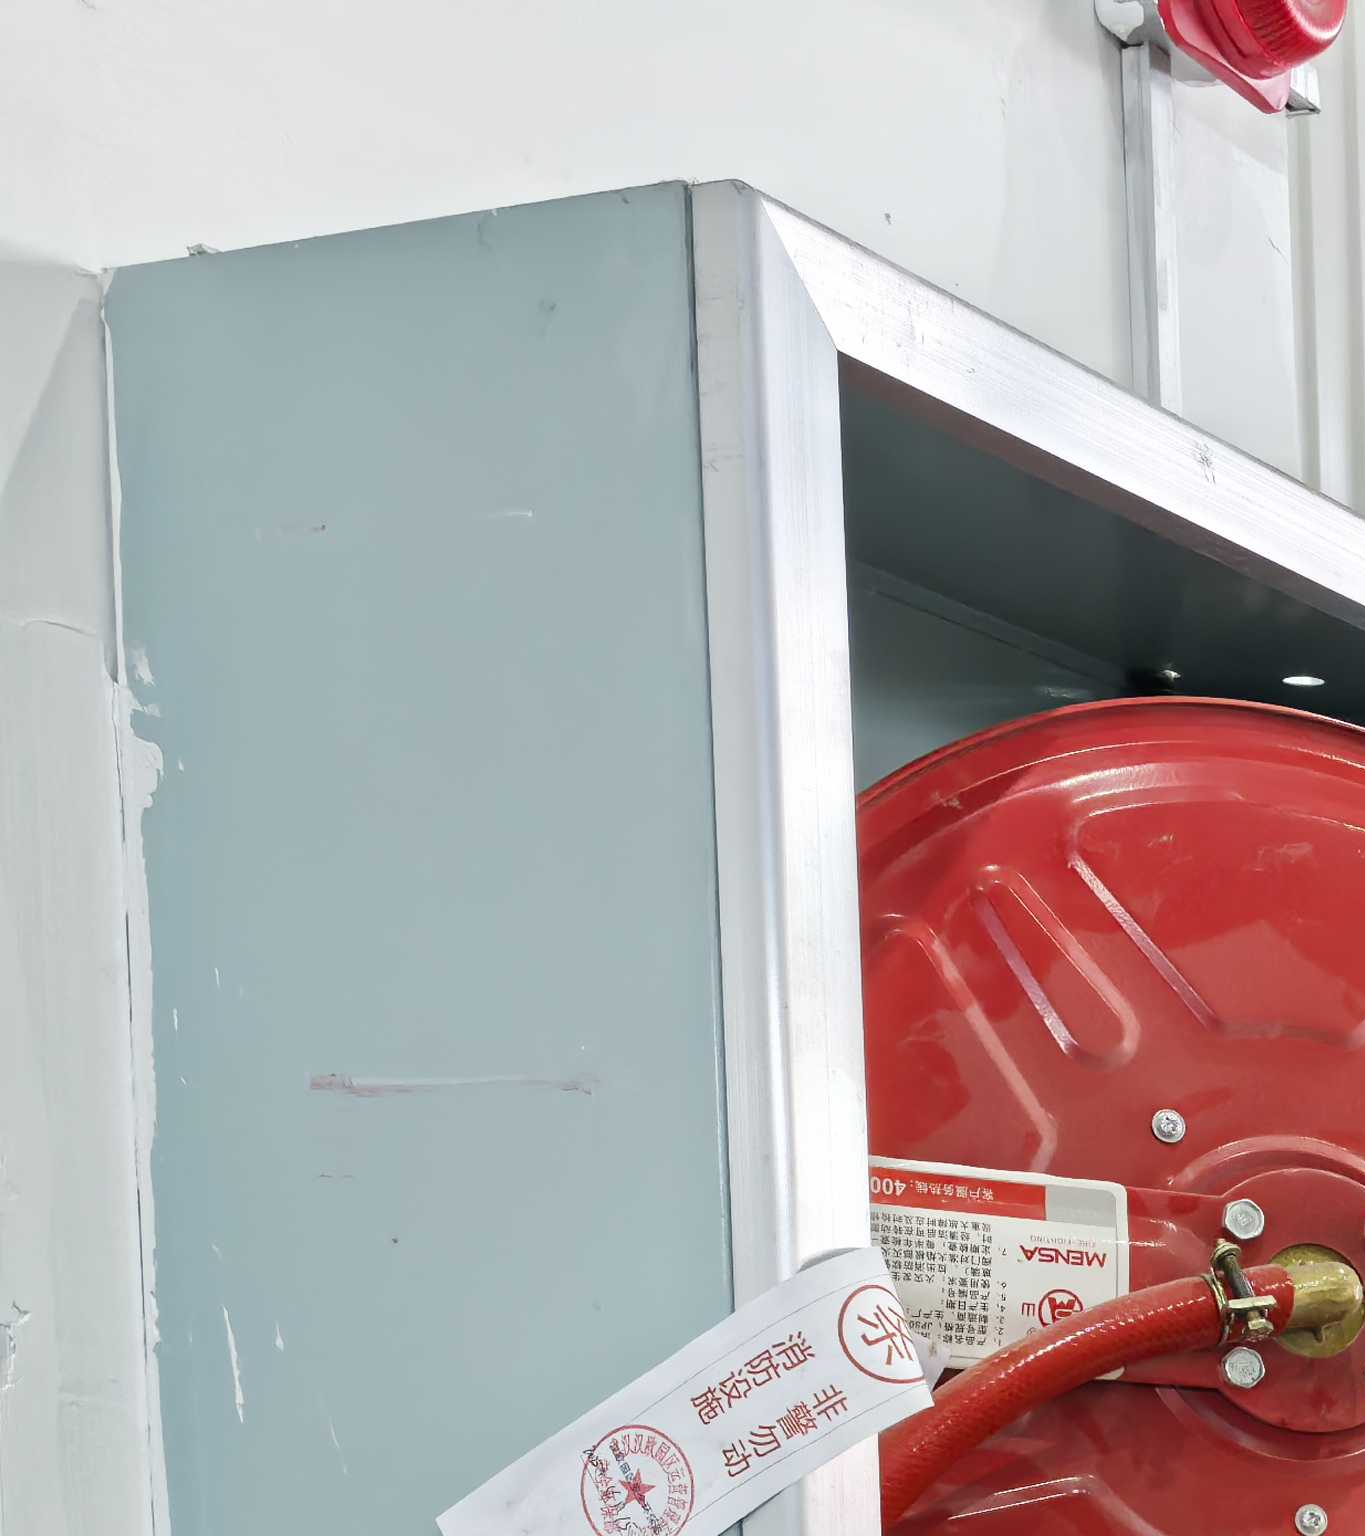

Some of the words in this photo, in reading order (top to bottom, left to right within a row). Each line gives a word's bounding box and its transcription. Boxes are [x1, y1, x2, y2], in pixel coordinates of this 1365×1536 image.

[1018, 1244, 1106, 1269] MENSA
[690, 1330, 817, 1426] 消防设施
[721, 1384, 851, 1479] 非警勿动
